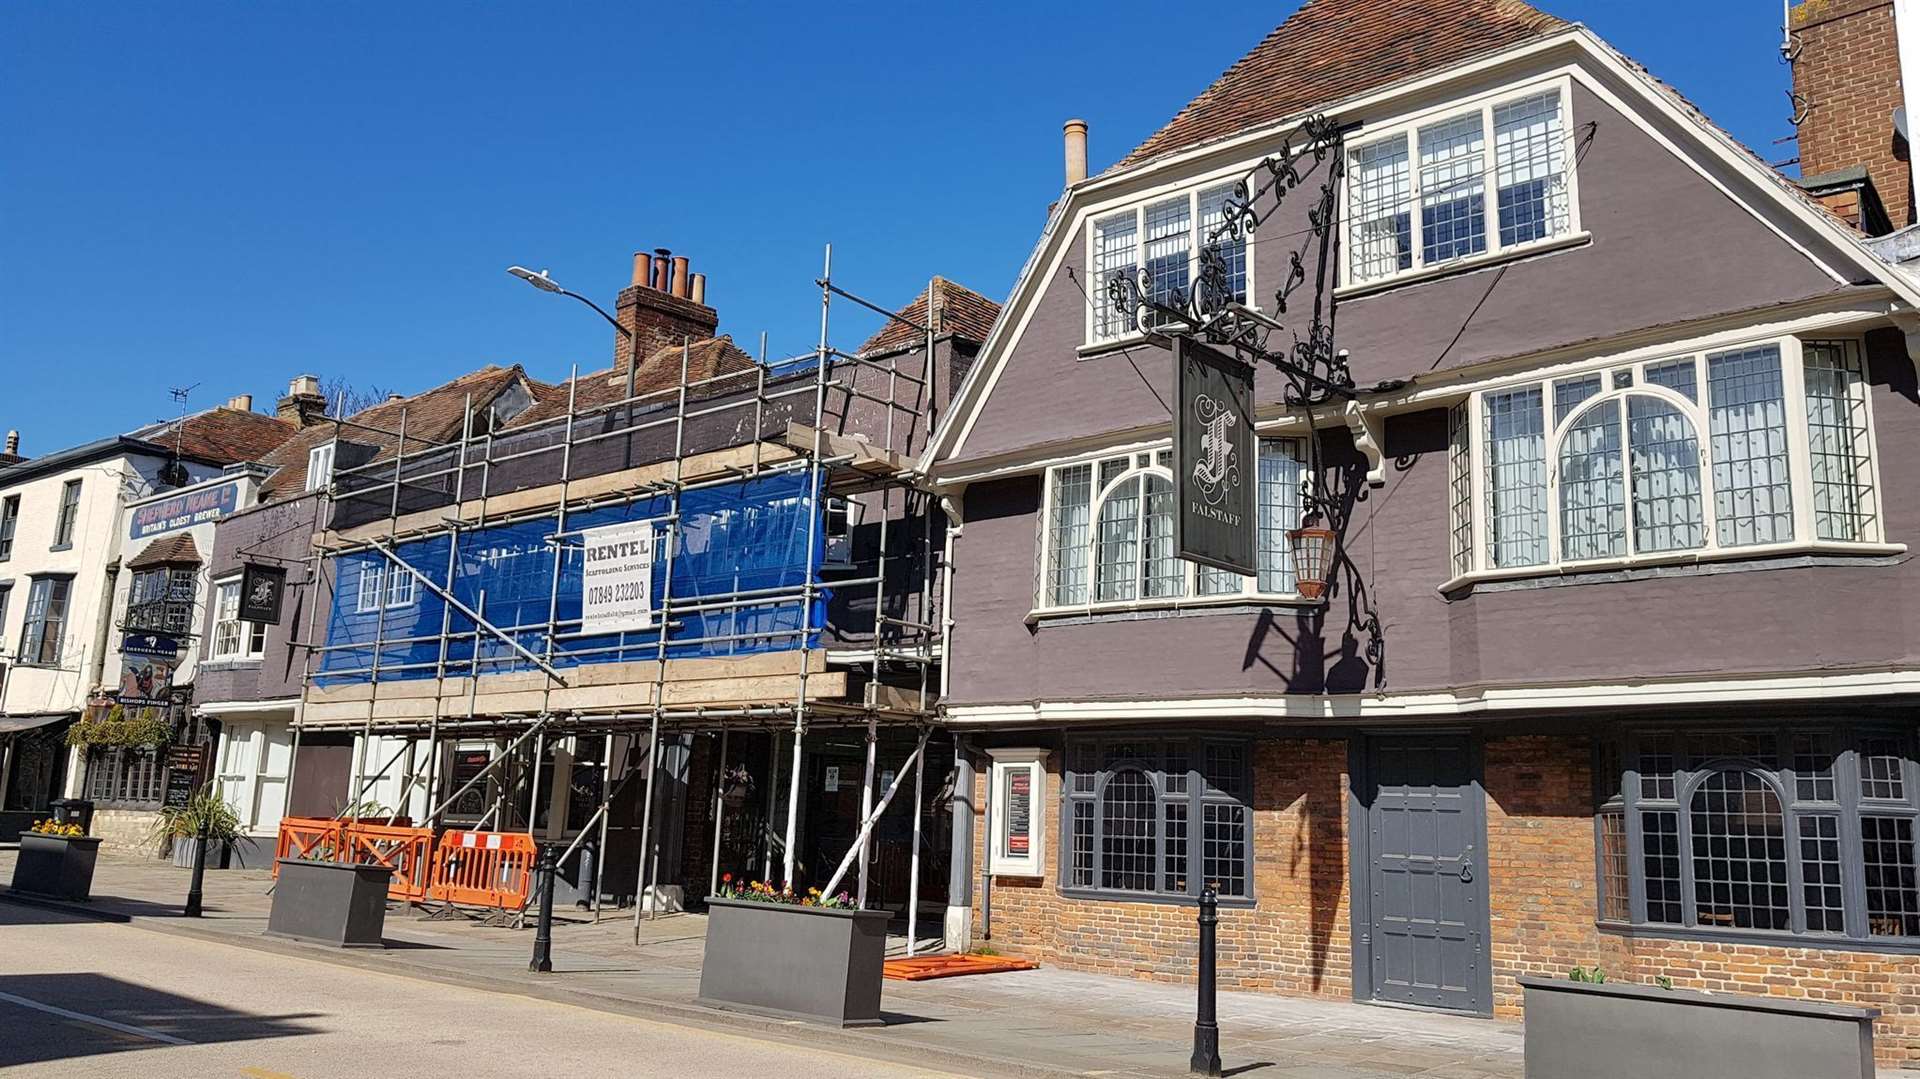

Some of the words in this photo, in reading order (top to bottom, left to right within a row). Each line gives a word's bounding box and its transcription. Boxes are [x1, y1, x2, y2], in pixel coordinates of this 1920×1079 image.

[185, 489, 218, 514] NEAME
[169, 515, 191, 528] OLDEST
[1192, 501, 1240, 526] FALSTAFF
[586, 540, 649, 562] RENTEL
[588, 585, 613, 605] 07849
[615, 581, 645, 602] 232203
[120, 697, 146, 705] BISHOPS
